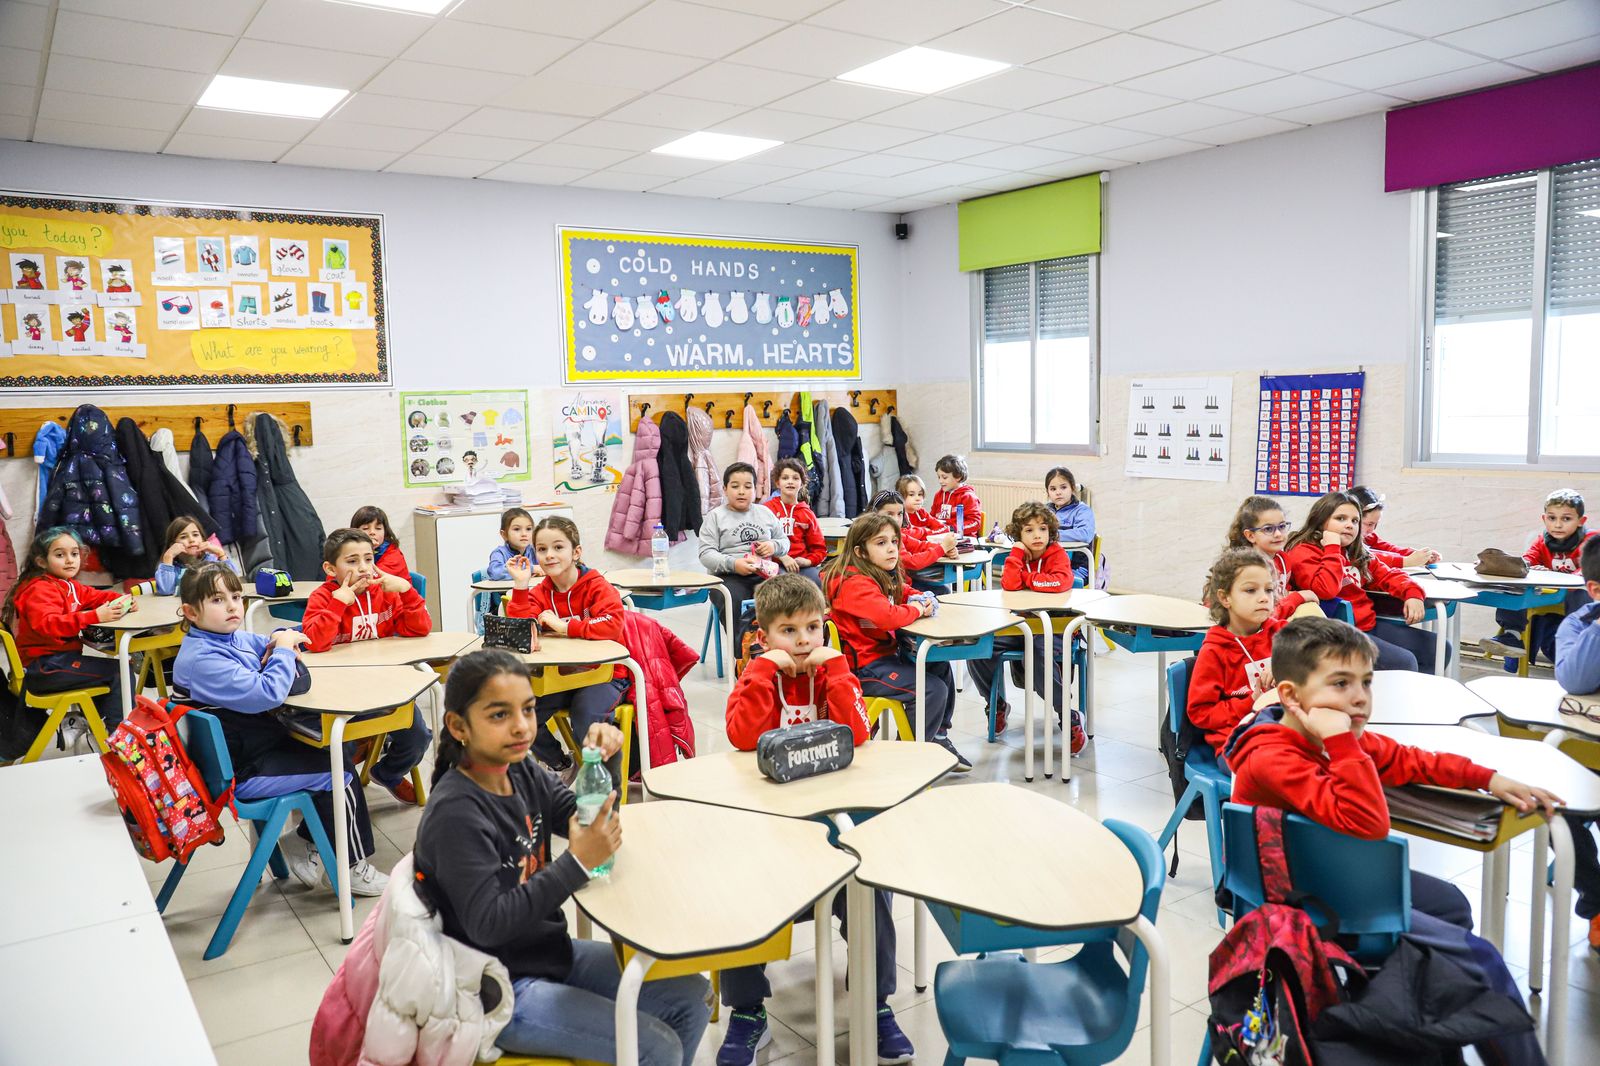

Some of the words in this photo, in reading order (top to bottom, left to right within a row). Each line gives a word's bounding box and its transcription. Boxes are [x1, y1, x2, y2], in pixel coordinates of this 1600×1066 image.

[2, 226, 28, 245] you
[276, 264, 304, 275] gloves
[325, 272, 346, 280] coat
[619, 256, 672, 274] COLD
[691, 259, 759, 280] HANDS
[310, 317, 335, 327] boots
[201, 341, 235, 361] What
[245, 345, 262, 356] are
[271, 347, 287, 366] you
[665, 343, 744, 366] WARM
[763, 342, 853, 365] HEARTS
[561, 405, 613, 418] CAMINOS
[788, 740, 840, 769] FORTNITE
